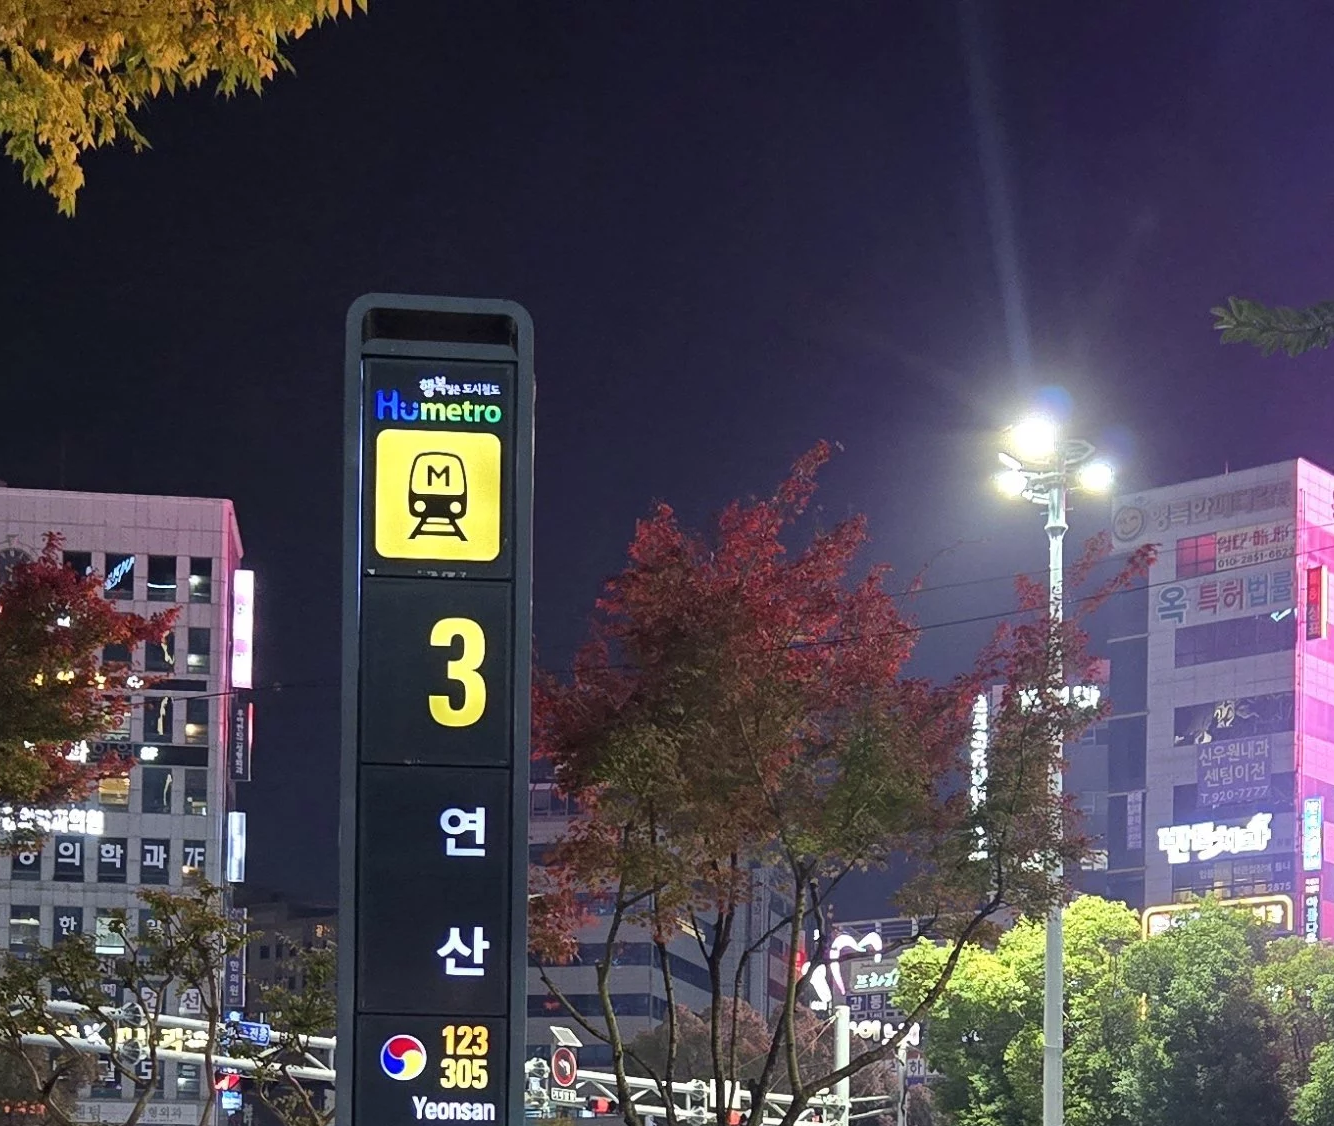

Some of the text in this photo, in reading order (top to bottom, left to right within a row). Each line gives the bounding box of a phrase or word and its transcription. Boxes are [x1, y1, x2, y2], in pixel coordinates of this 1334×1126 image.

[462, 383, 501, 396] 도시철도
[376, 389, 502, 422] Humetro
[429, 618, 486, 727] 3
[1204, 763, 1266, 788] 센텀이전
[441, 1025, 489, 1056] 123
[440, 1058, 489, 1089] 305
[412, 1096, 496, 1121] Yeonsan
